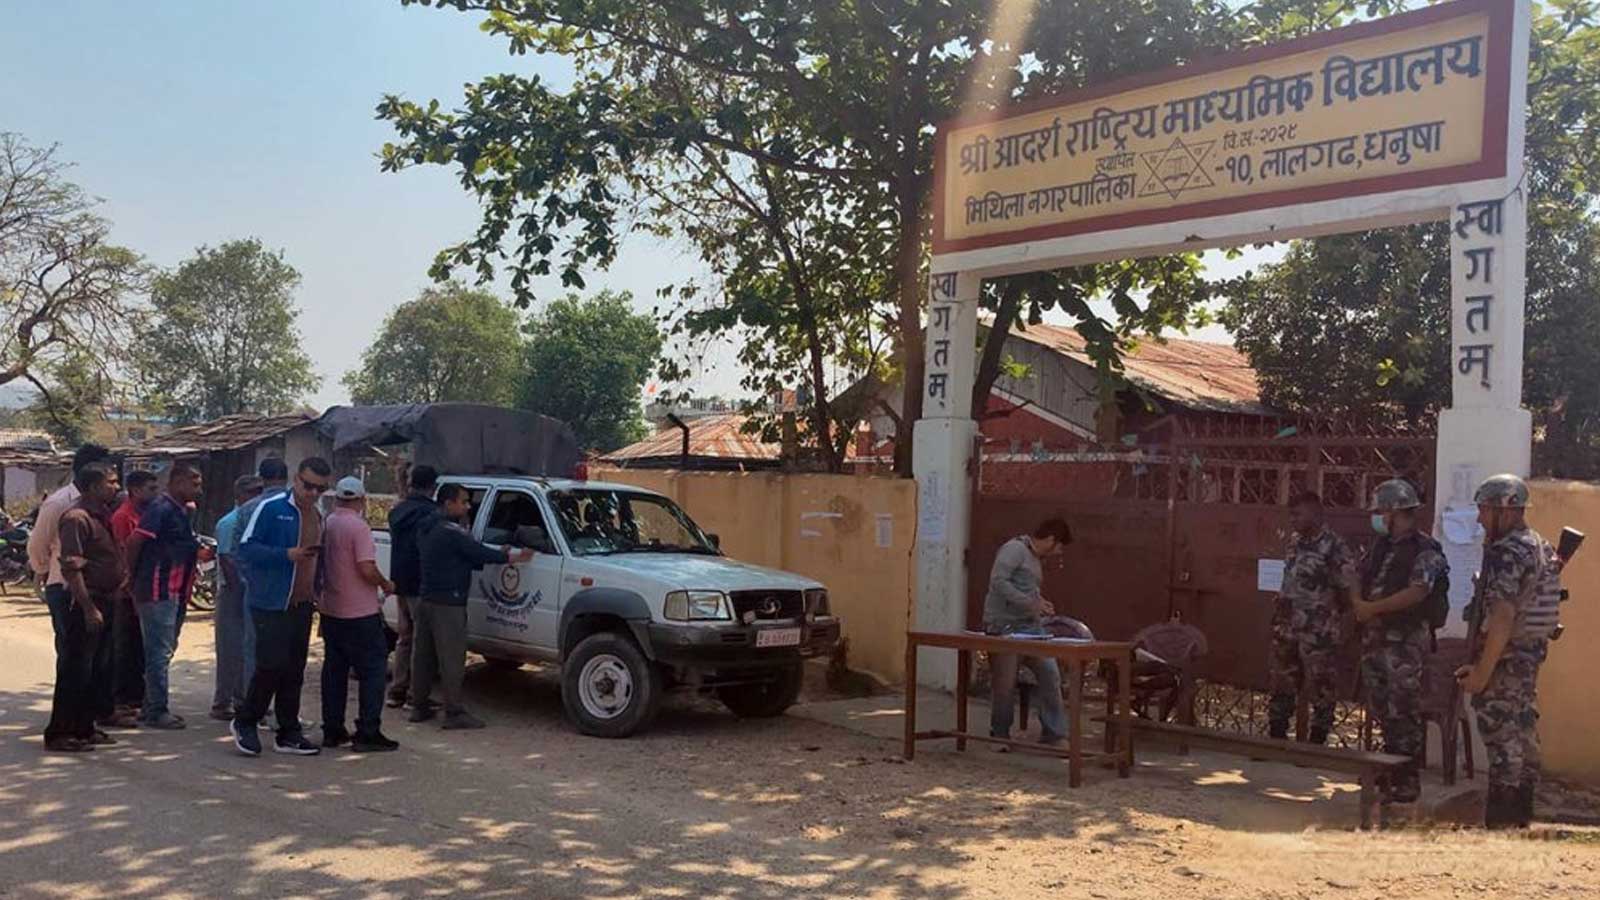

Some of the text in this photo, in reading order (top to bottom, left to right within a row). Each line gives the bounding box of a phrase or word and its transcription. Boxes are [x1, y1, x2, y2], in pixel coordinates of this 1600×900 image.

[960, 35, 1483, 175] श्री आदर्श राष्ट्रिय माध्यमिक विद्यालय
[964, 190, 1026, 226] मिथिला
[1028, 172, 1137, 214] नगरपालिका
